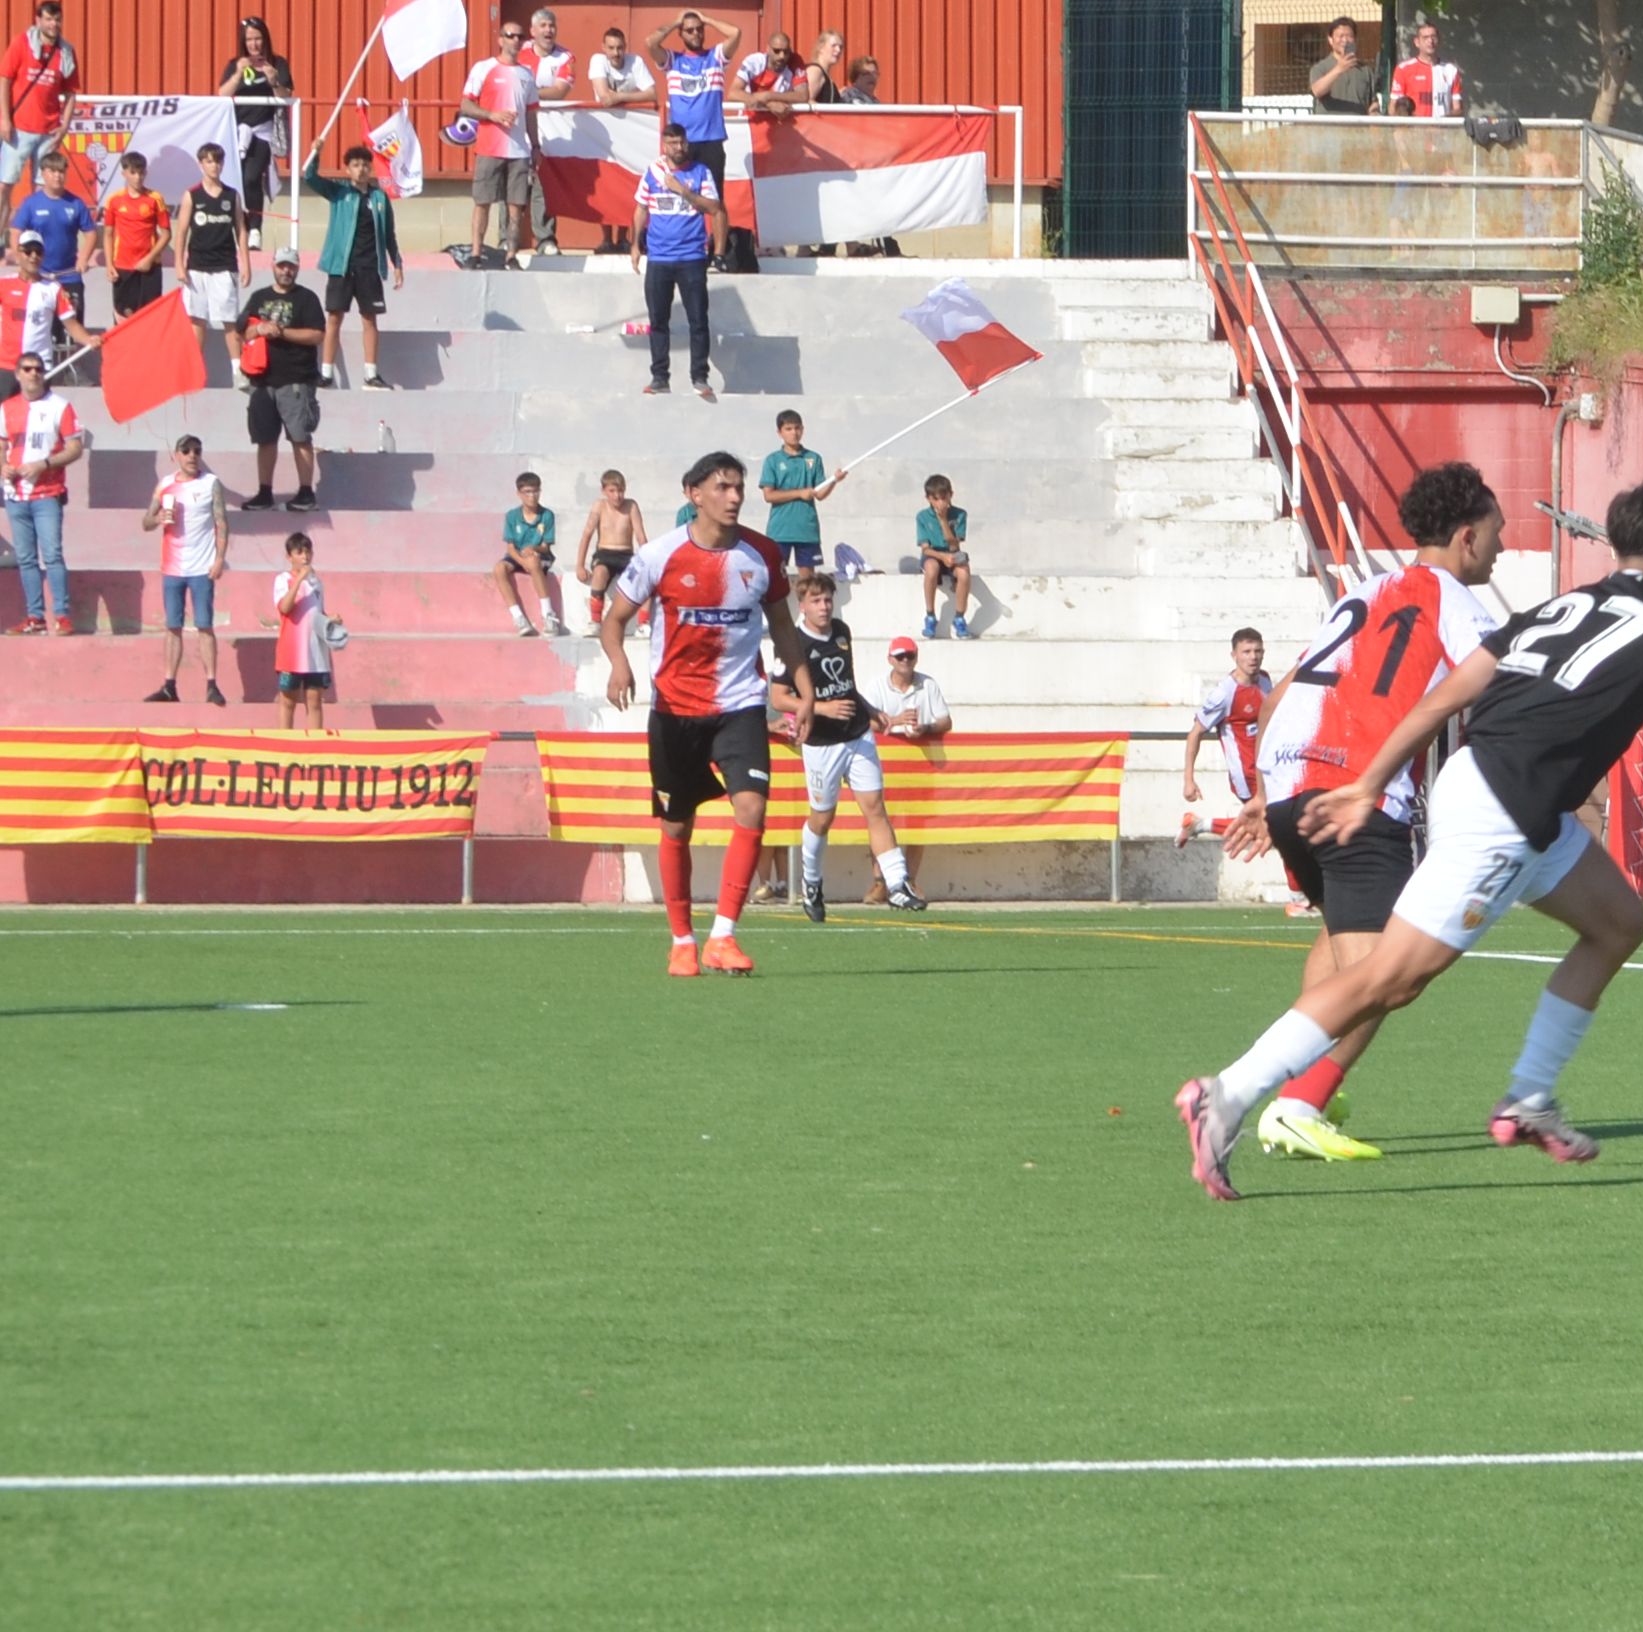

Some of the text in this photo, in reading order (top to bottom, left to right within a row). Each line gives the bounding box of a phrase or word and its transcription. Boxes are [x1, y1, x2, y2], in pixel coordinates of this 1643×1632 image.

[1293, 597, 1422, 698] 21
[388, 759, 475, 810] 1912
[1475, 852, 1524, 902] 27
